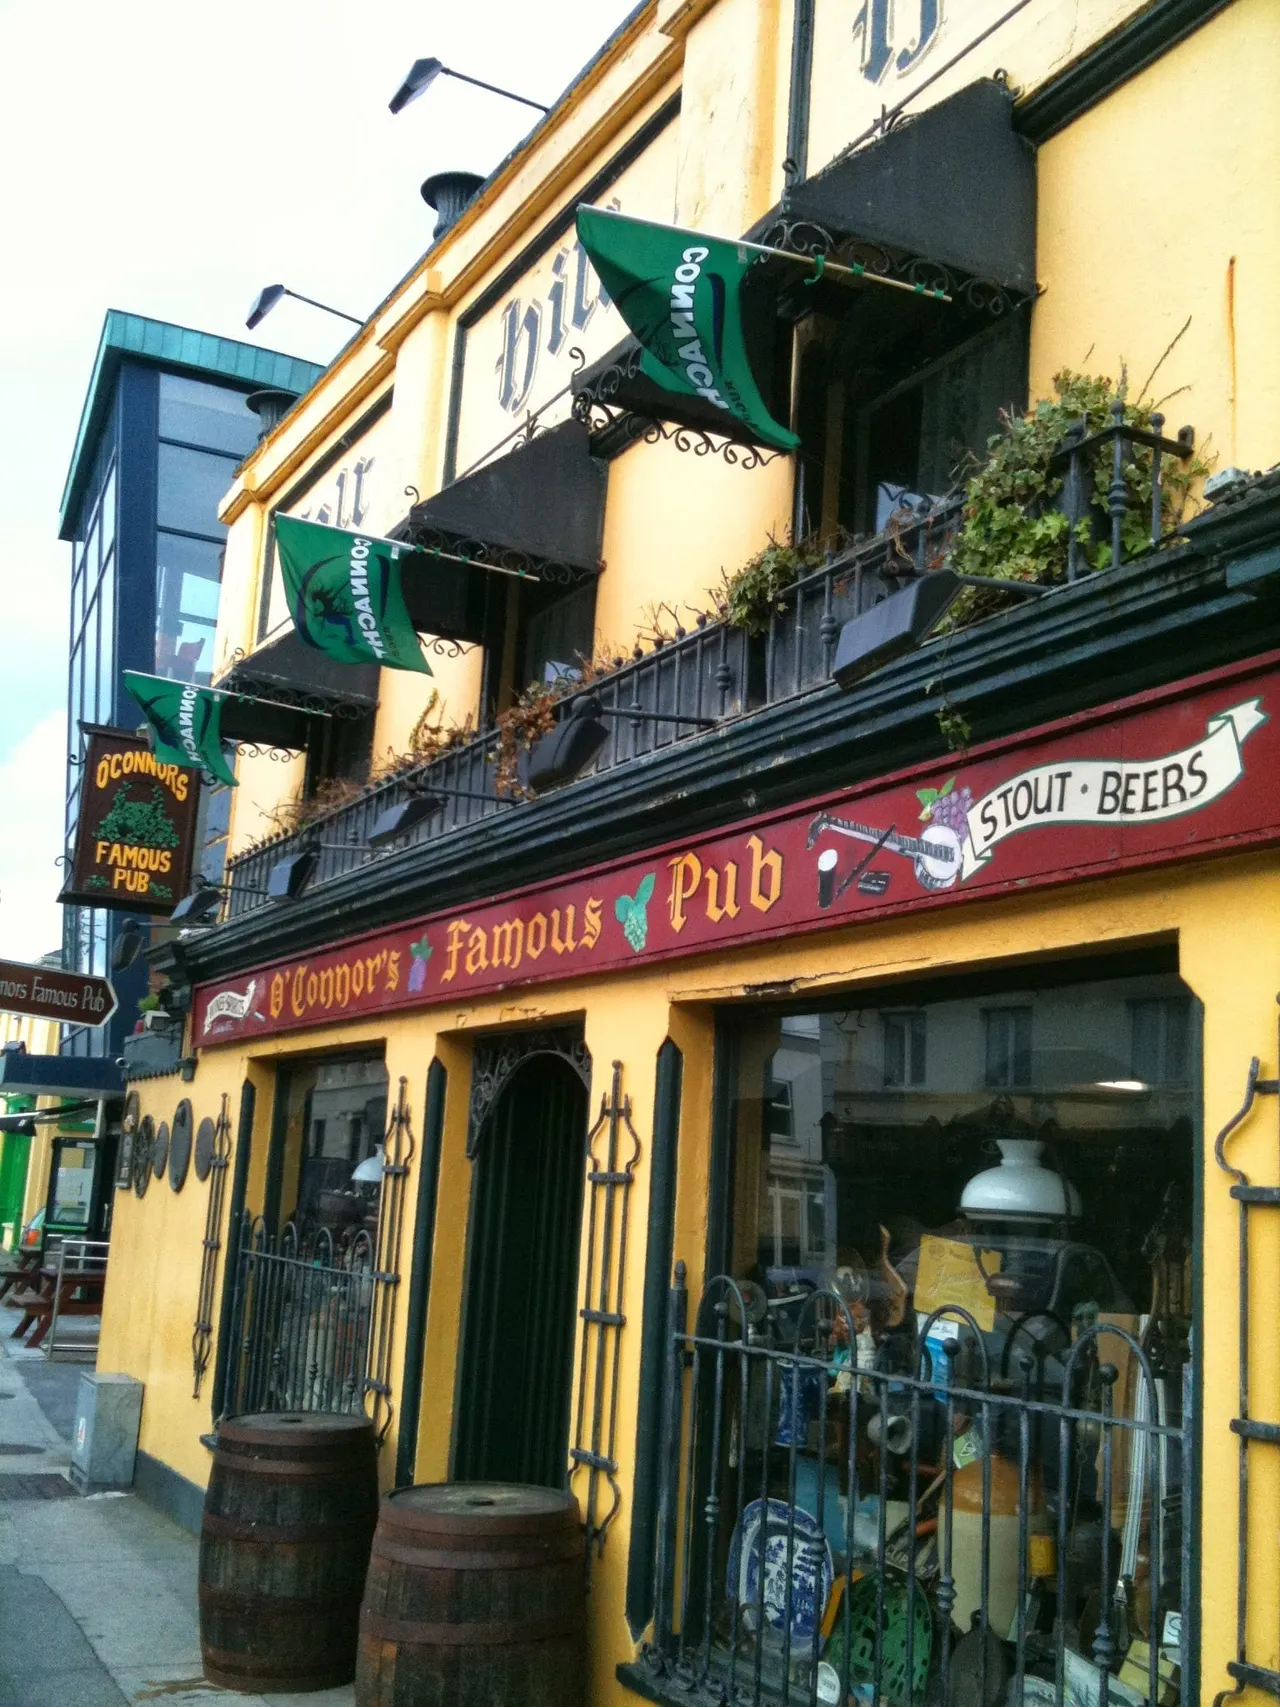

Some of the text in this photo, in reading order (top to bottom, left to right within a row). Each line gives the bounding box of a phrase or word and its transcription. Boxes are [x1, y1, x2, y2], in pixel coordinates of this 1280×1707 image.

[980, 750, 1208, 842] STOUT BEERS
[95, 840, 172, 873] FAMOUS
[113, 868, 150, 893] PUB
[269, 834, 785, 1020] O'Connor's Famous Pub
[30, 975, 79, 1008] Famous
[81, 985, 105, 1012] Pub
